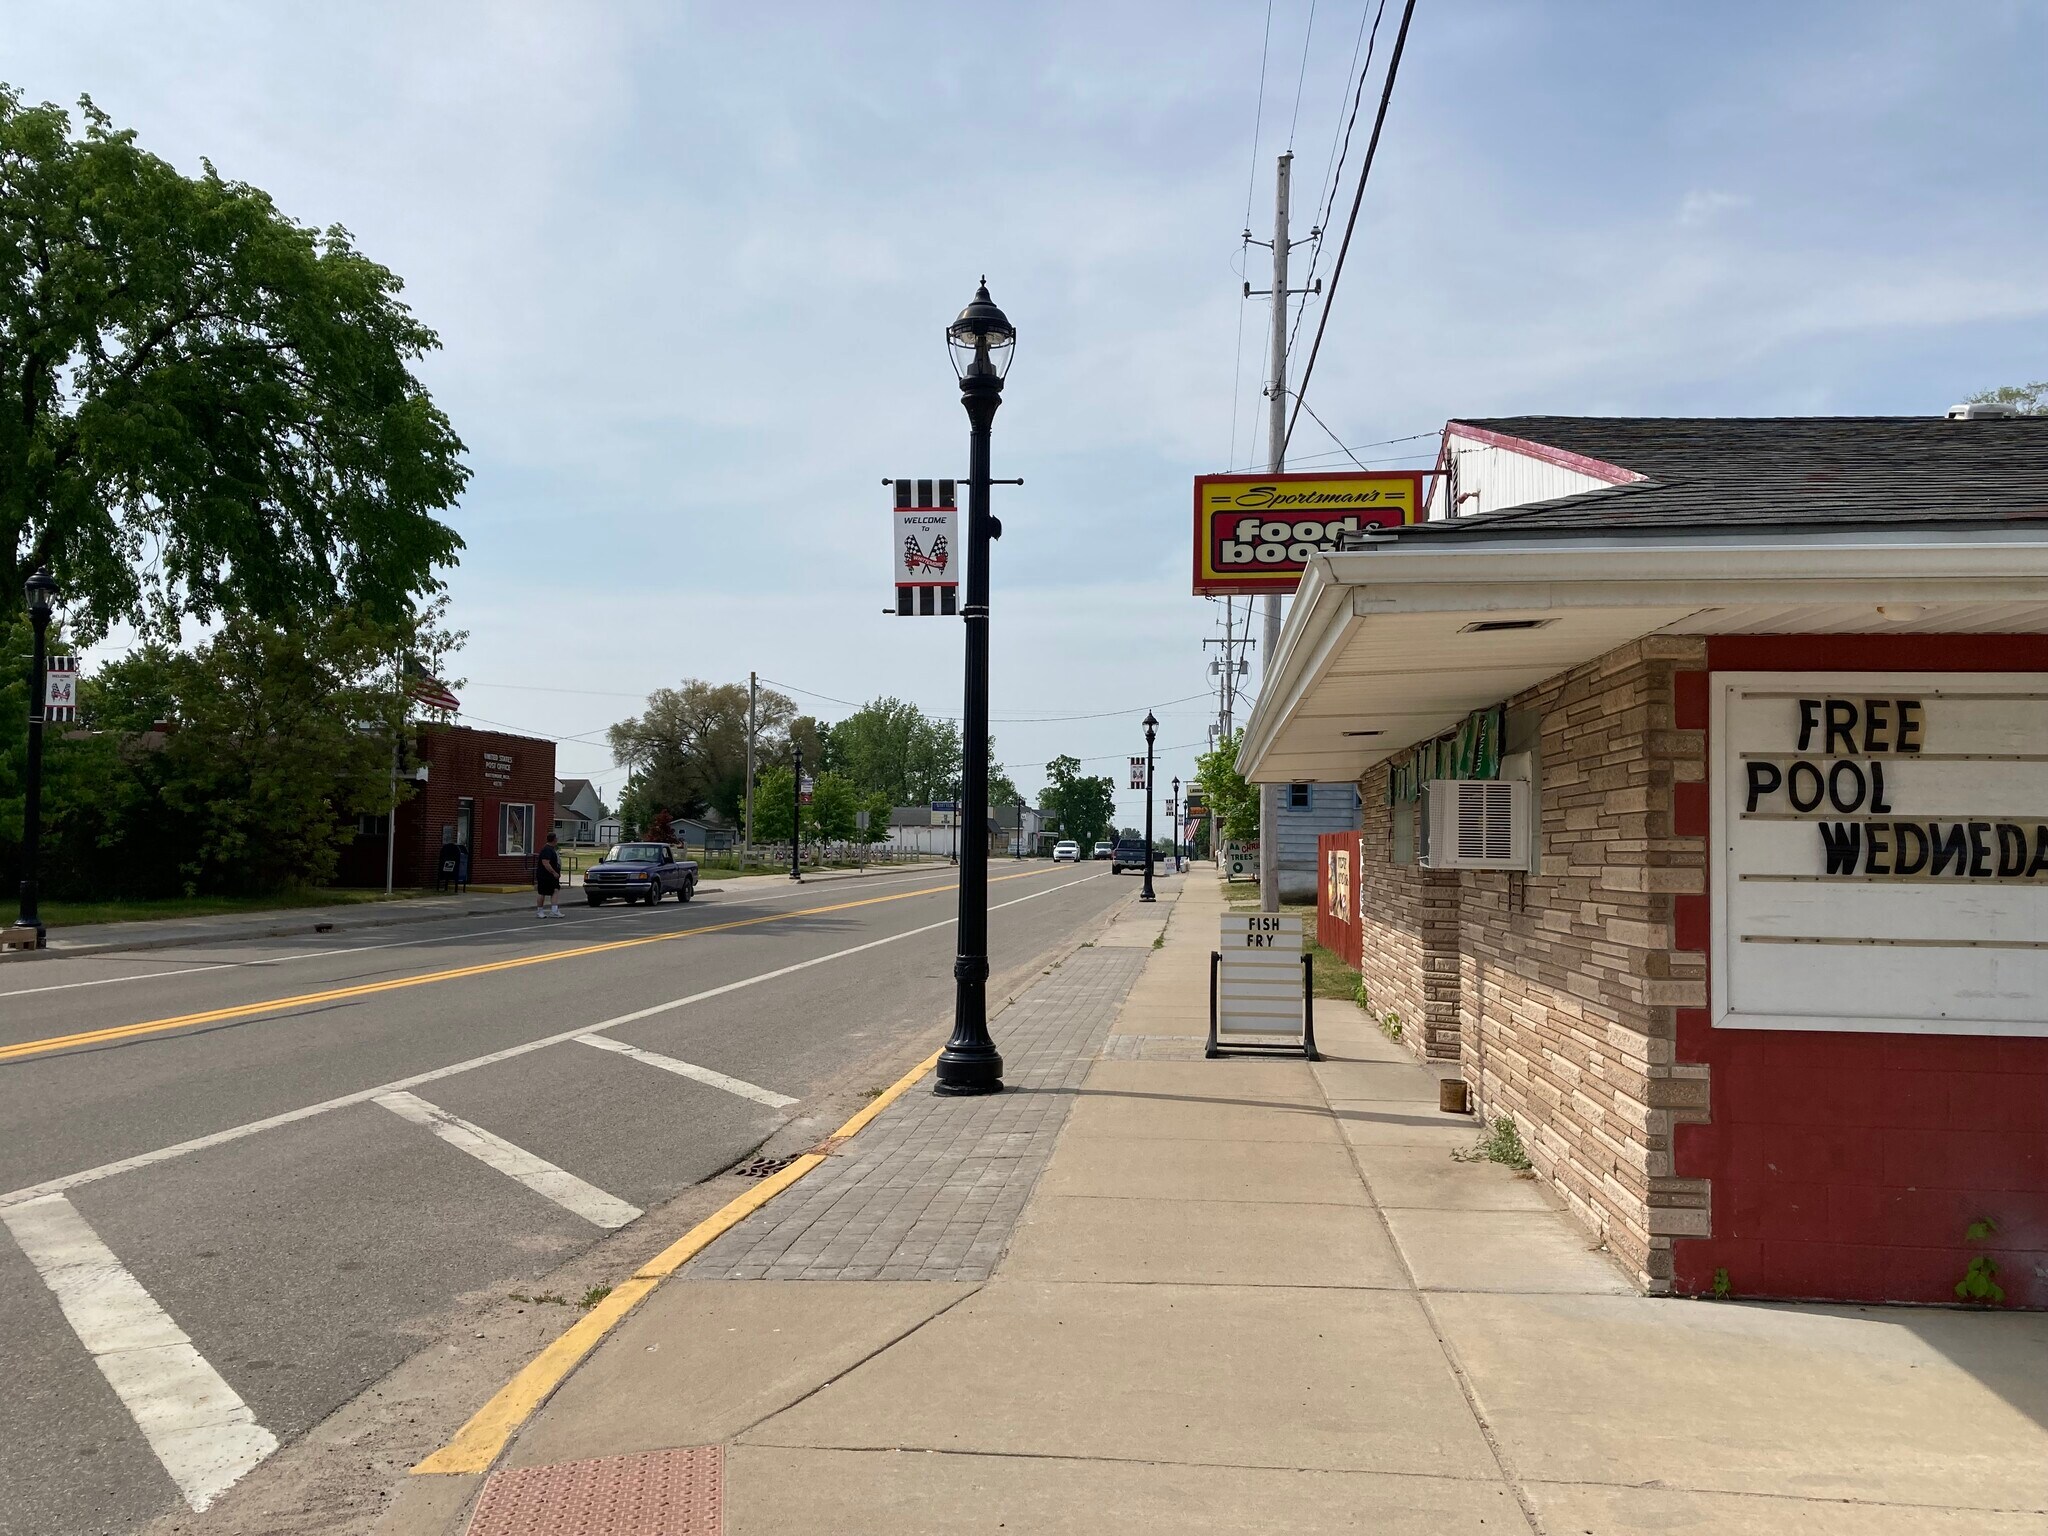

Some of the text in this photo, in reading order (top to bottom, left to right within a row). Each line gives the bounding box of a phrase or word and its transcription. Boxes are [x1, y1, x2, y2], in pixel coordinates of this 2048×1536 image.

[1235, 486, 1381, 508] Sportsman's
[1236, 516, 1358, 543] food
[1797, 699, 1922, 754] FREE
[1476, 720, 1488, 772] GUINNESS
[486, 761, 511, 771] POST OFFICE
[1746, 759, 1892, 815] POOL
[1231, 853, 1253, 861] TREES
[1248, 917, 1280, 932] FISH
[1247, 933, 1274, 948] FRY
